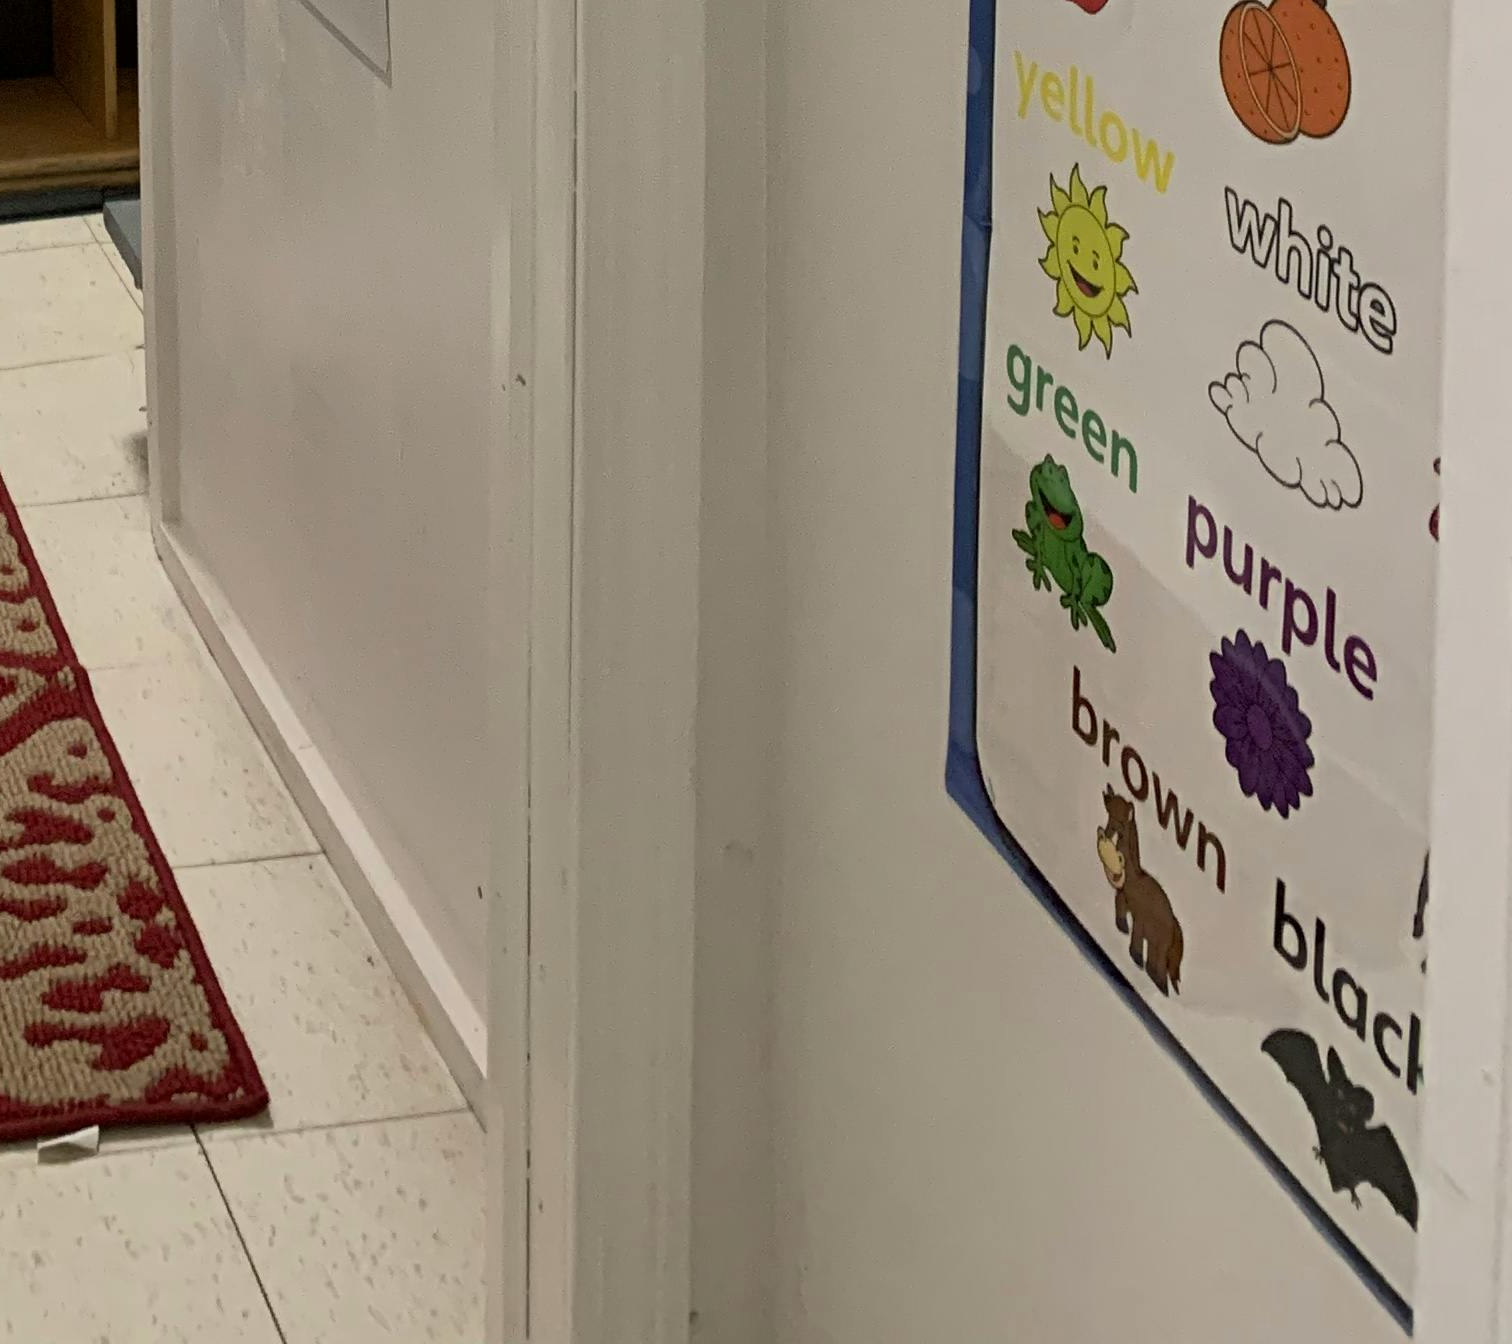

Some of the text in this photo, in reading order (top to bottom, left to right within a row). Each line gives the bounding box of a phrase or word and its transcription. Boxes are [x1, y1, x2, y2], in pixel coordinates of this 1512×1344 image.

[1013, 50, 1176, 194] yellow
[1224, 185, 1397, 355] white
[1006, 343, 1139, 494] green
[1185, 495, 1378, 701] purple
[1071, 666, 1226, 894] brown
